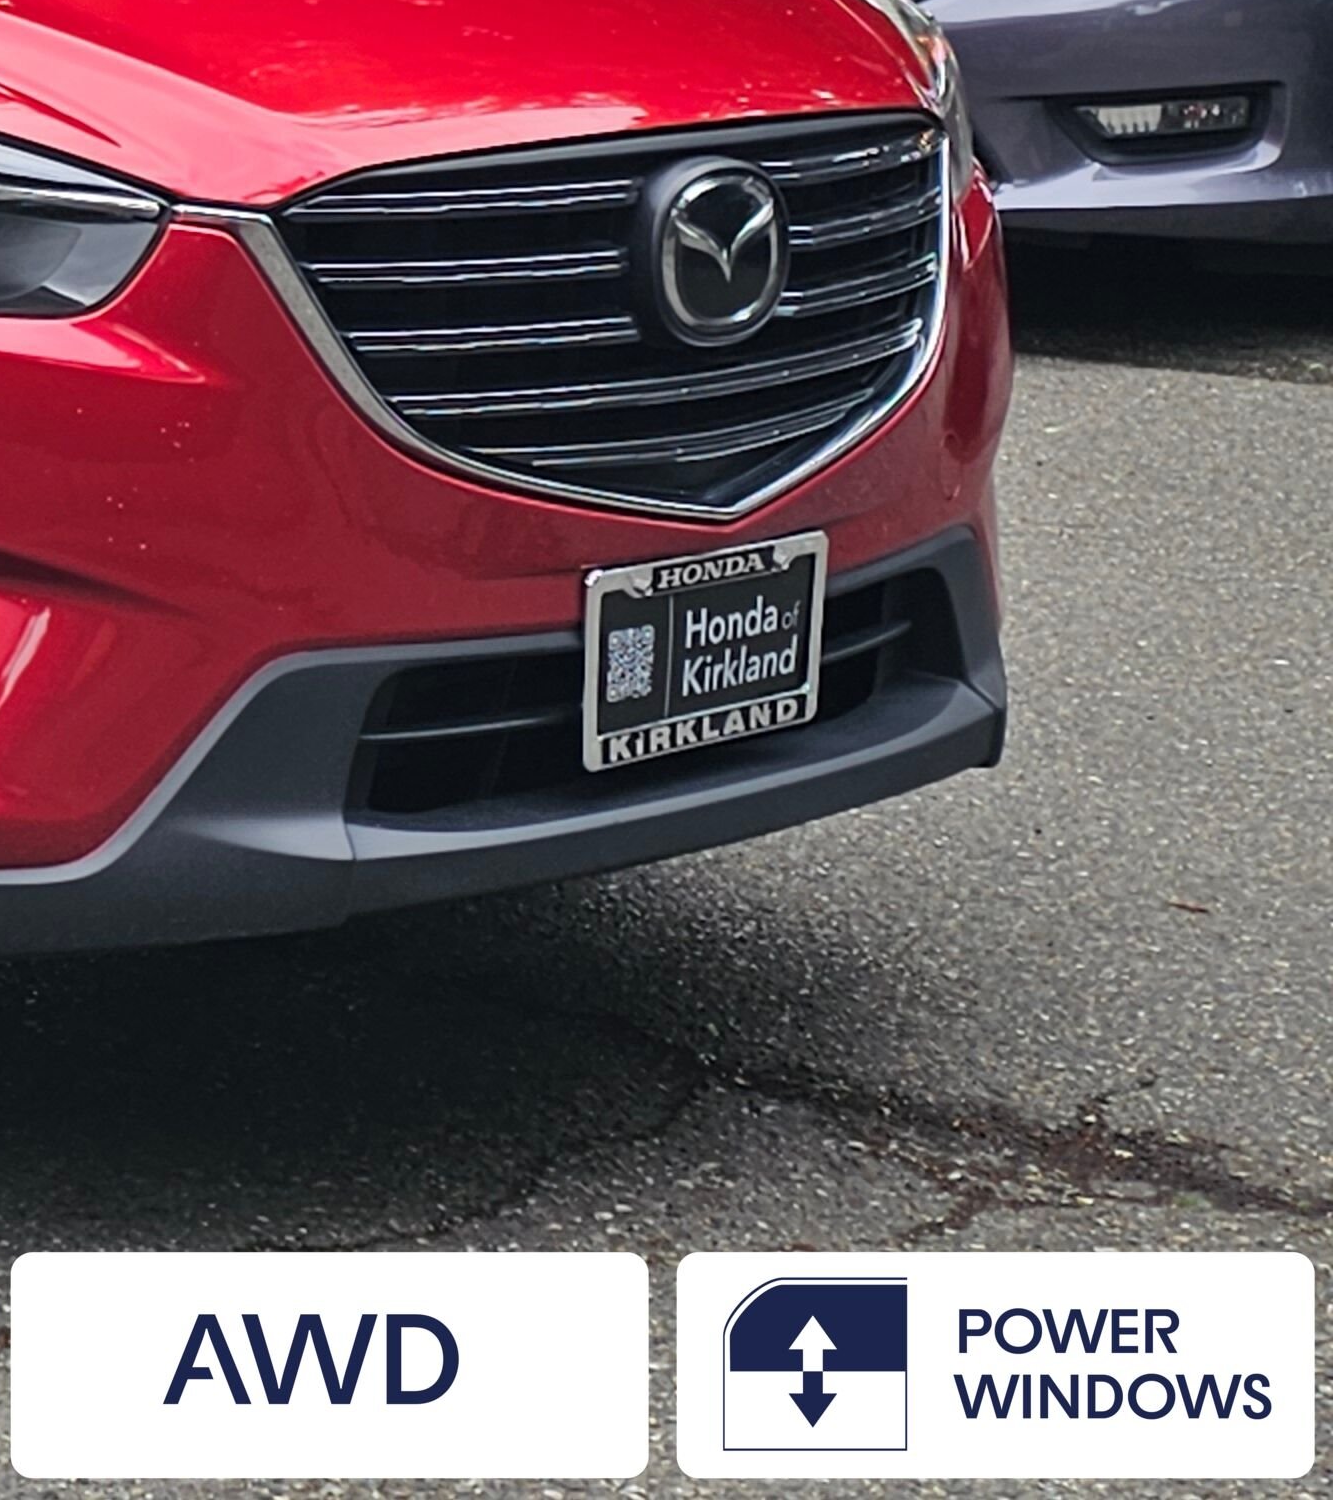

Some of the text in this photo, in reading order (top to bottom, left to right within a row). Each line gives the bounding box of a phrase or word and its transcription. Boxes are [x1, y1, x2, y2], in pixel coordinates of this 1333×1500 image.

[657, 553, 765, 588] HONDA
[685, 595, 801, 649] Honda of
[682, 634, 798, 697] Kirkland
[608, 698, 799, 762] KIRKLAND
